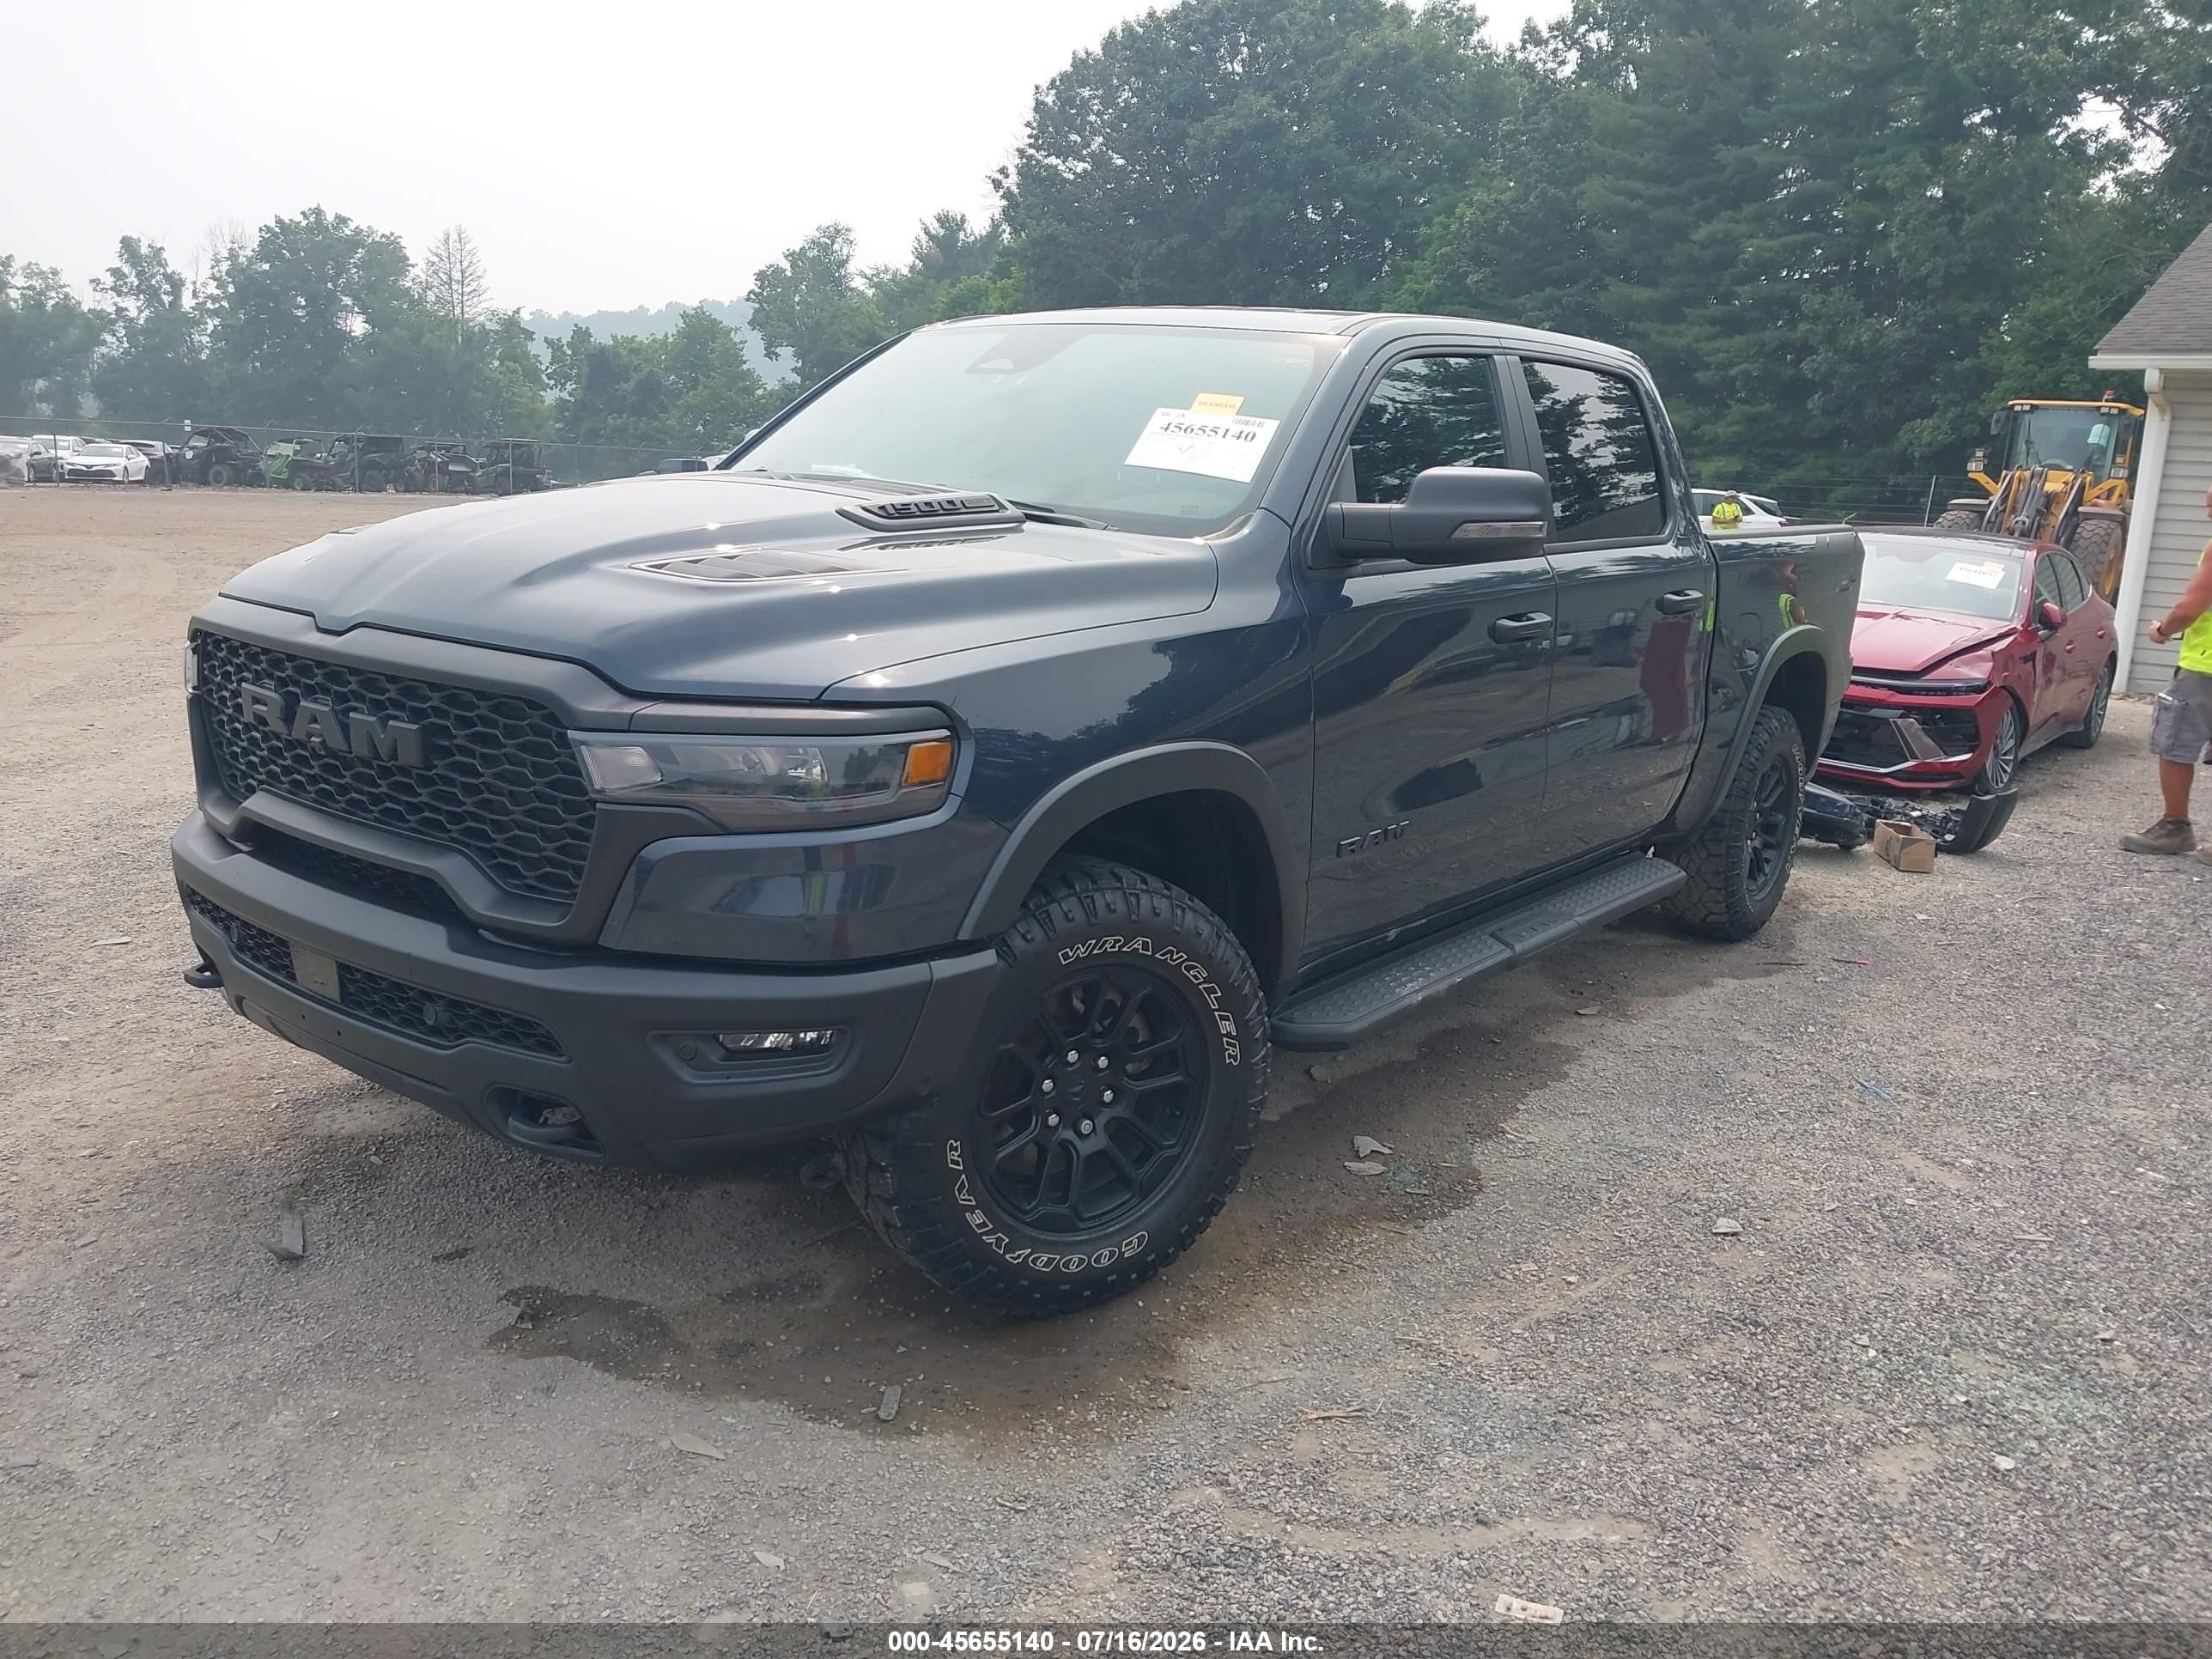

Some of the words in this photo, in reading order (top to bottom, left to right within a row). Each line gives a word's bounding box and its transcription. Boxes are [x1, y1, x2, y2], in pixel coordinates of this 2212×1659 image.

[1159, 422, 1257, 443] 45655140
[878, 498, 963, 516] 1500
[241, 682, 426, 769] RAM
[1058, 936, 1242, 1066] WRANGLER
[946, 1139, 1149, 1272] GOODYEAR
